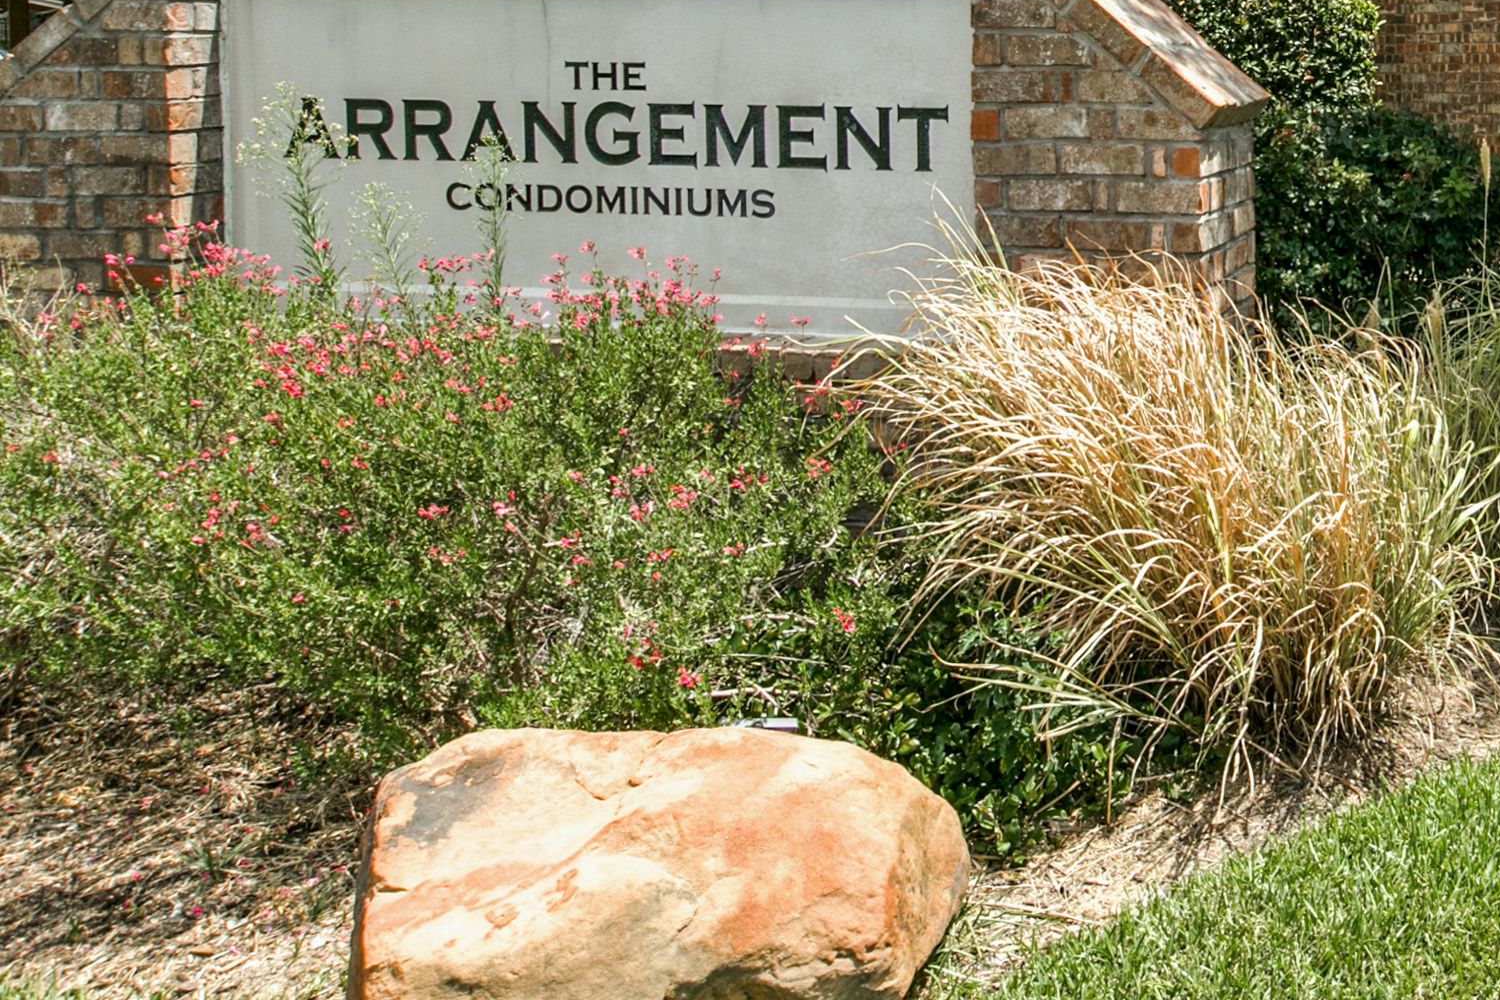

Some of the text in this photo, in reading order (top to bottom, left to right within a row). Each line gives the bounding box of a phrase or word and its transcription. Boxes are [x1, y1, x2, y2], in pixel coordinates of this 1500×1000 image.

[565, 61, 647, 91] THE
[284, 97, 949, 172] ARRANGEMENT
[446, 183, 776, 219] CONDOMINIUMS
